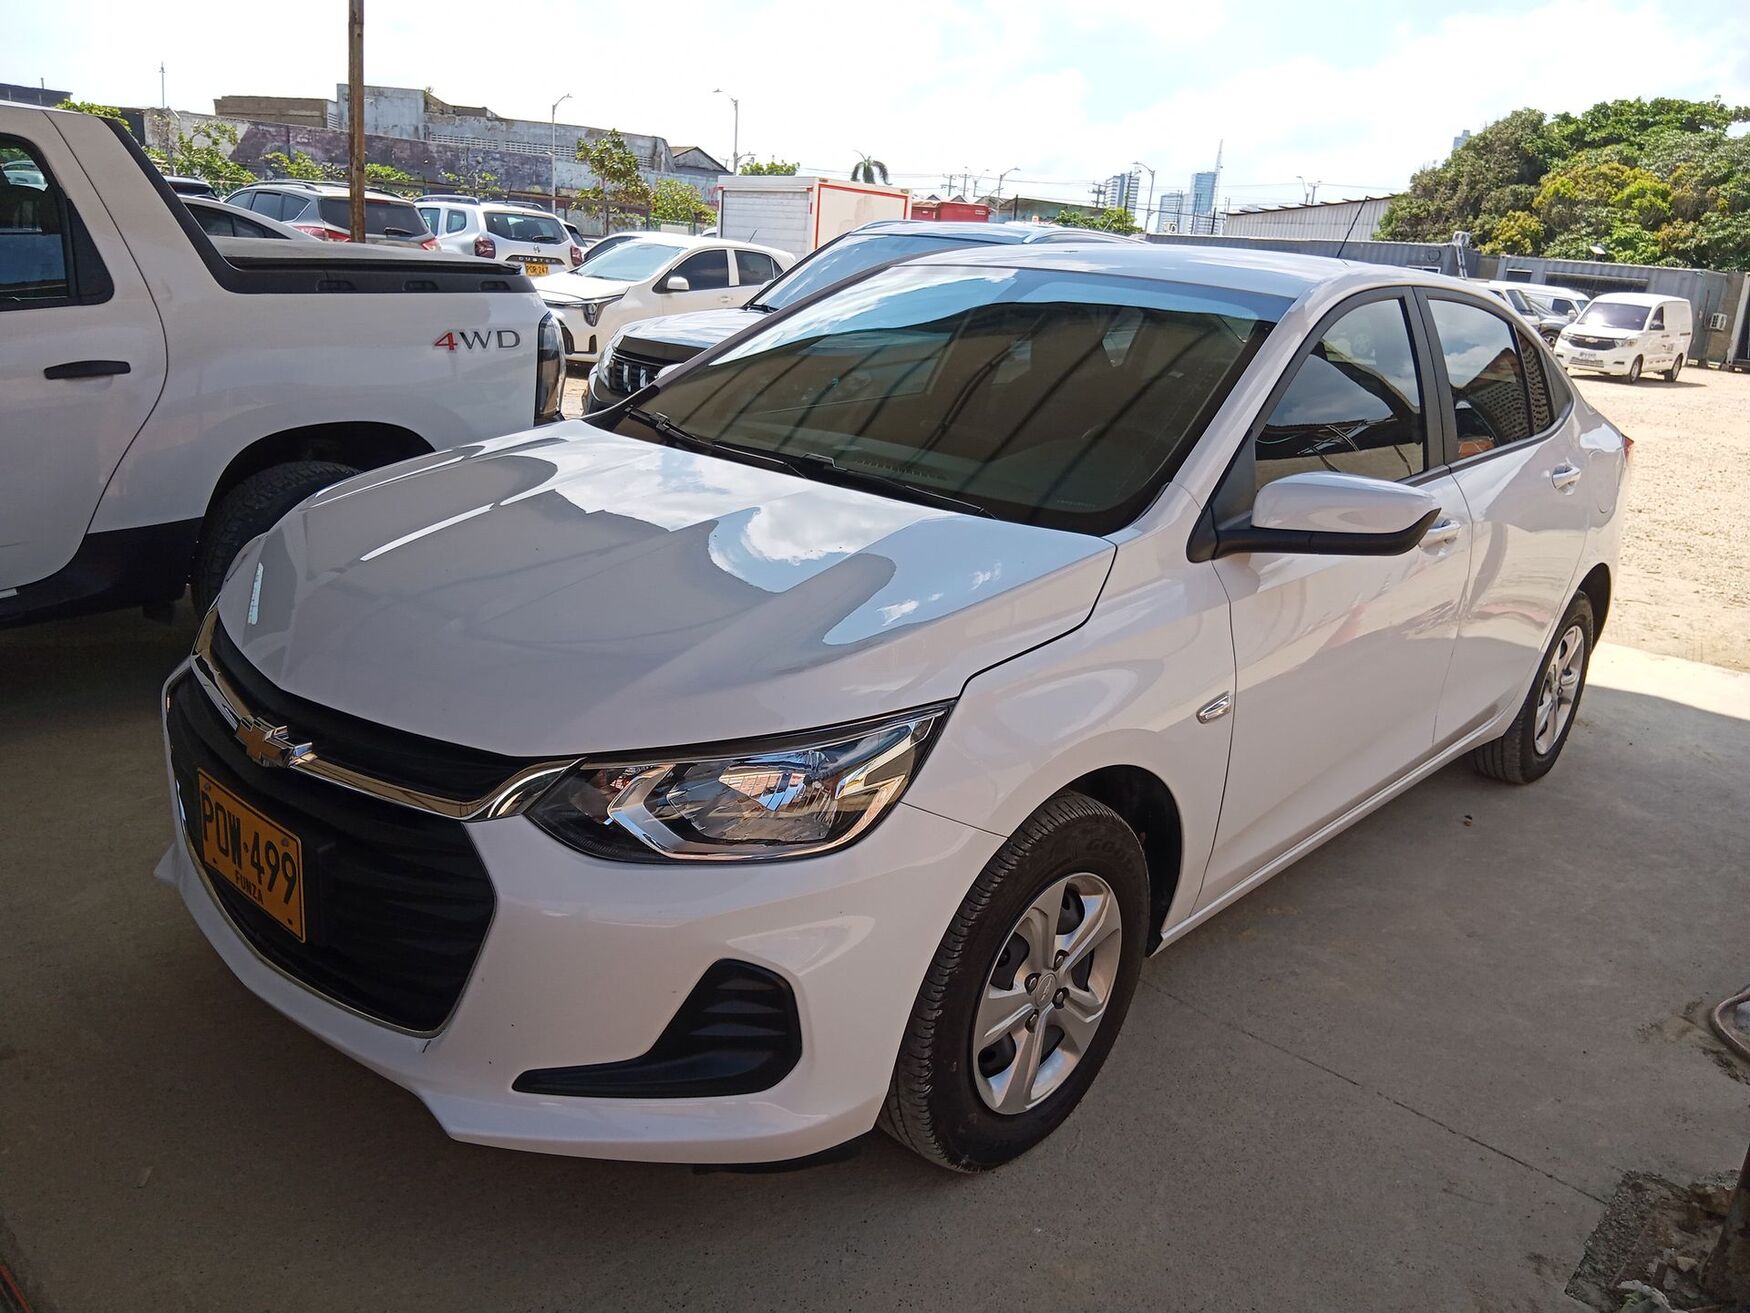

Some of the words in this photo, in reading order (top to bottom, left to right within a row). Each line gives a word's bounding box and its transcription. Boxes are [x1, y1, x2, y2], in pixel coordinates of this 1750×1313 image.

[518, 256, 556, 264] DUSTER
[433, 329, 521, 351] 4WD
[235, 869, 265, 906] FUNZA
